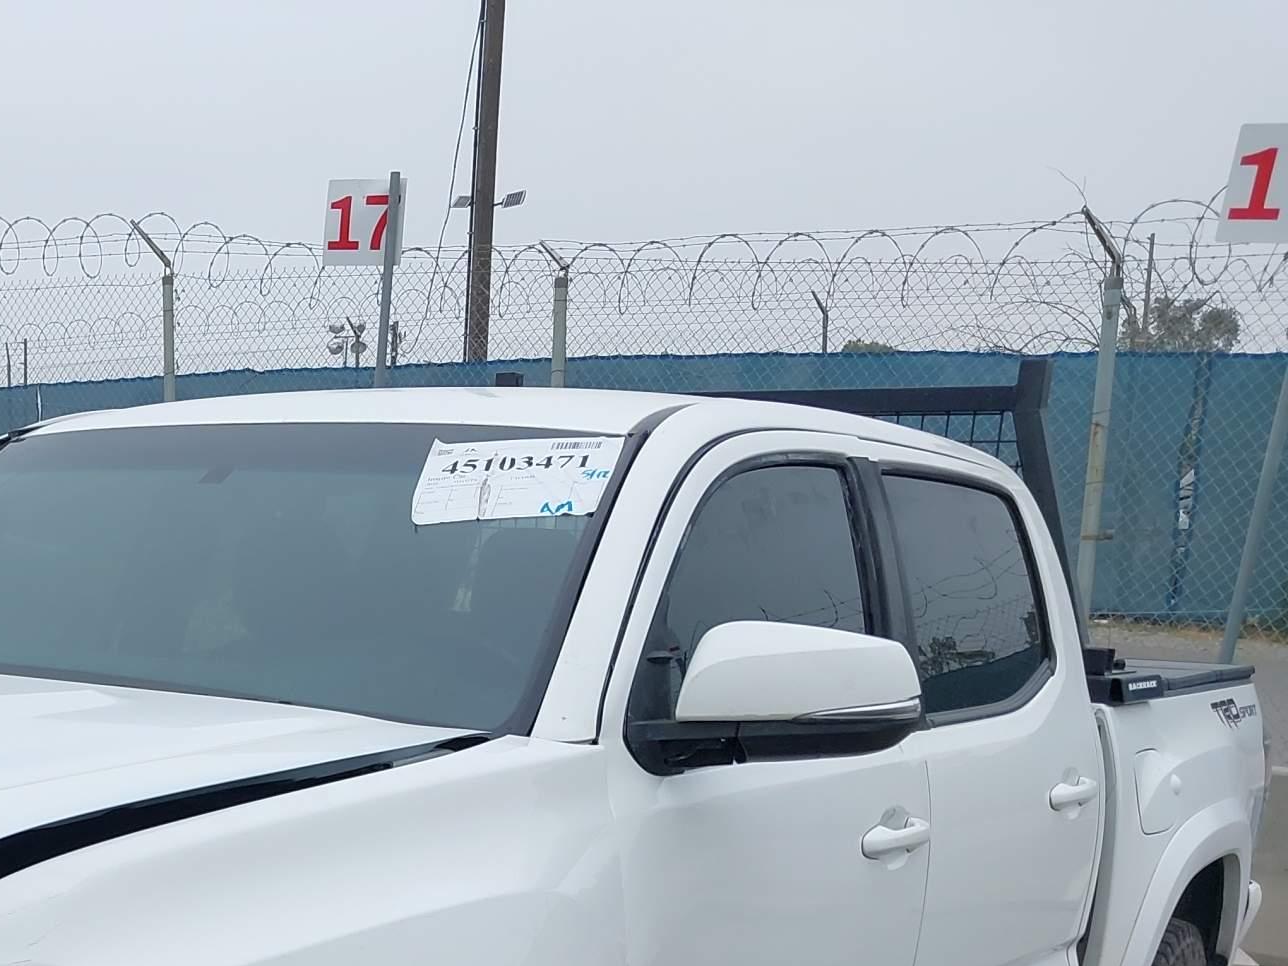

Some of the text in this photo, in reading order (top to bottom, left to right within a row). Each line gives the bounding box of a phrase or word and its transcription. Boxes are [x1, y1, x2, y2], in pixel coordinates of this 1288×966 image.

[327, 194, 389, 250] 17
[441, 454, 591, 475] 45103471
[1239, 704, 1257, 719] SPORT
